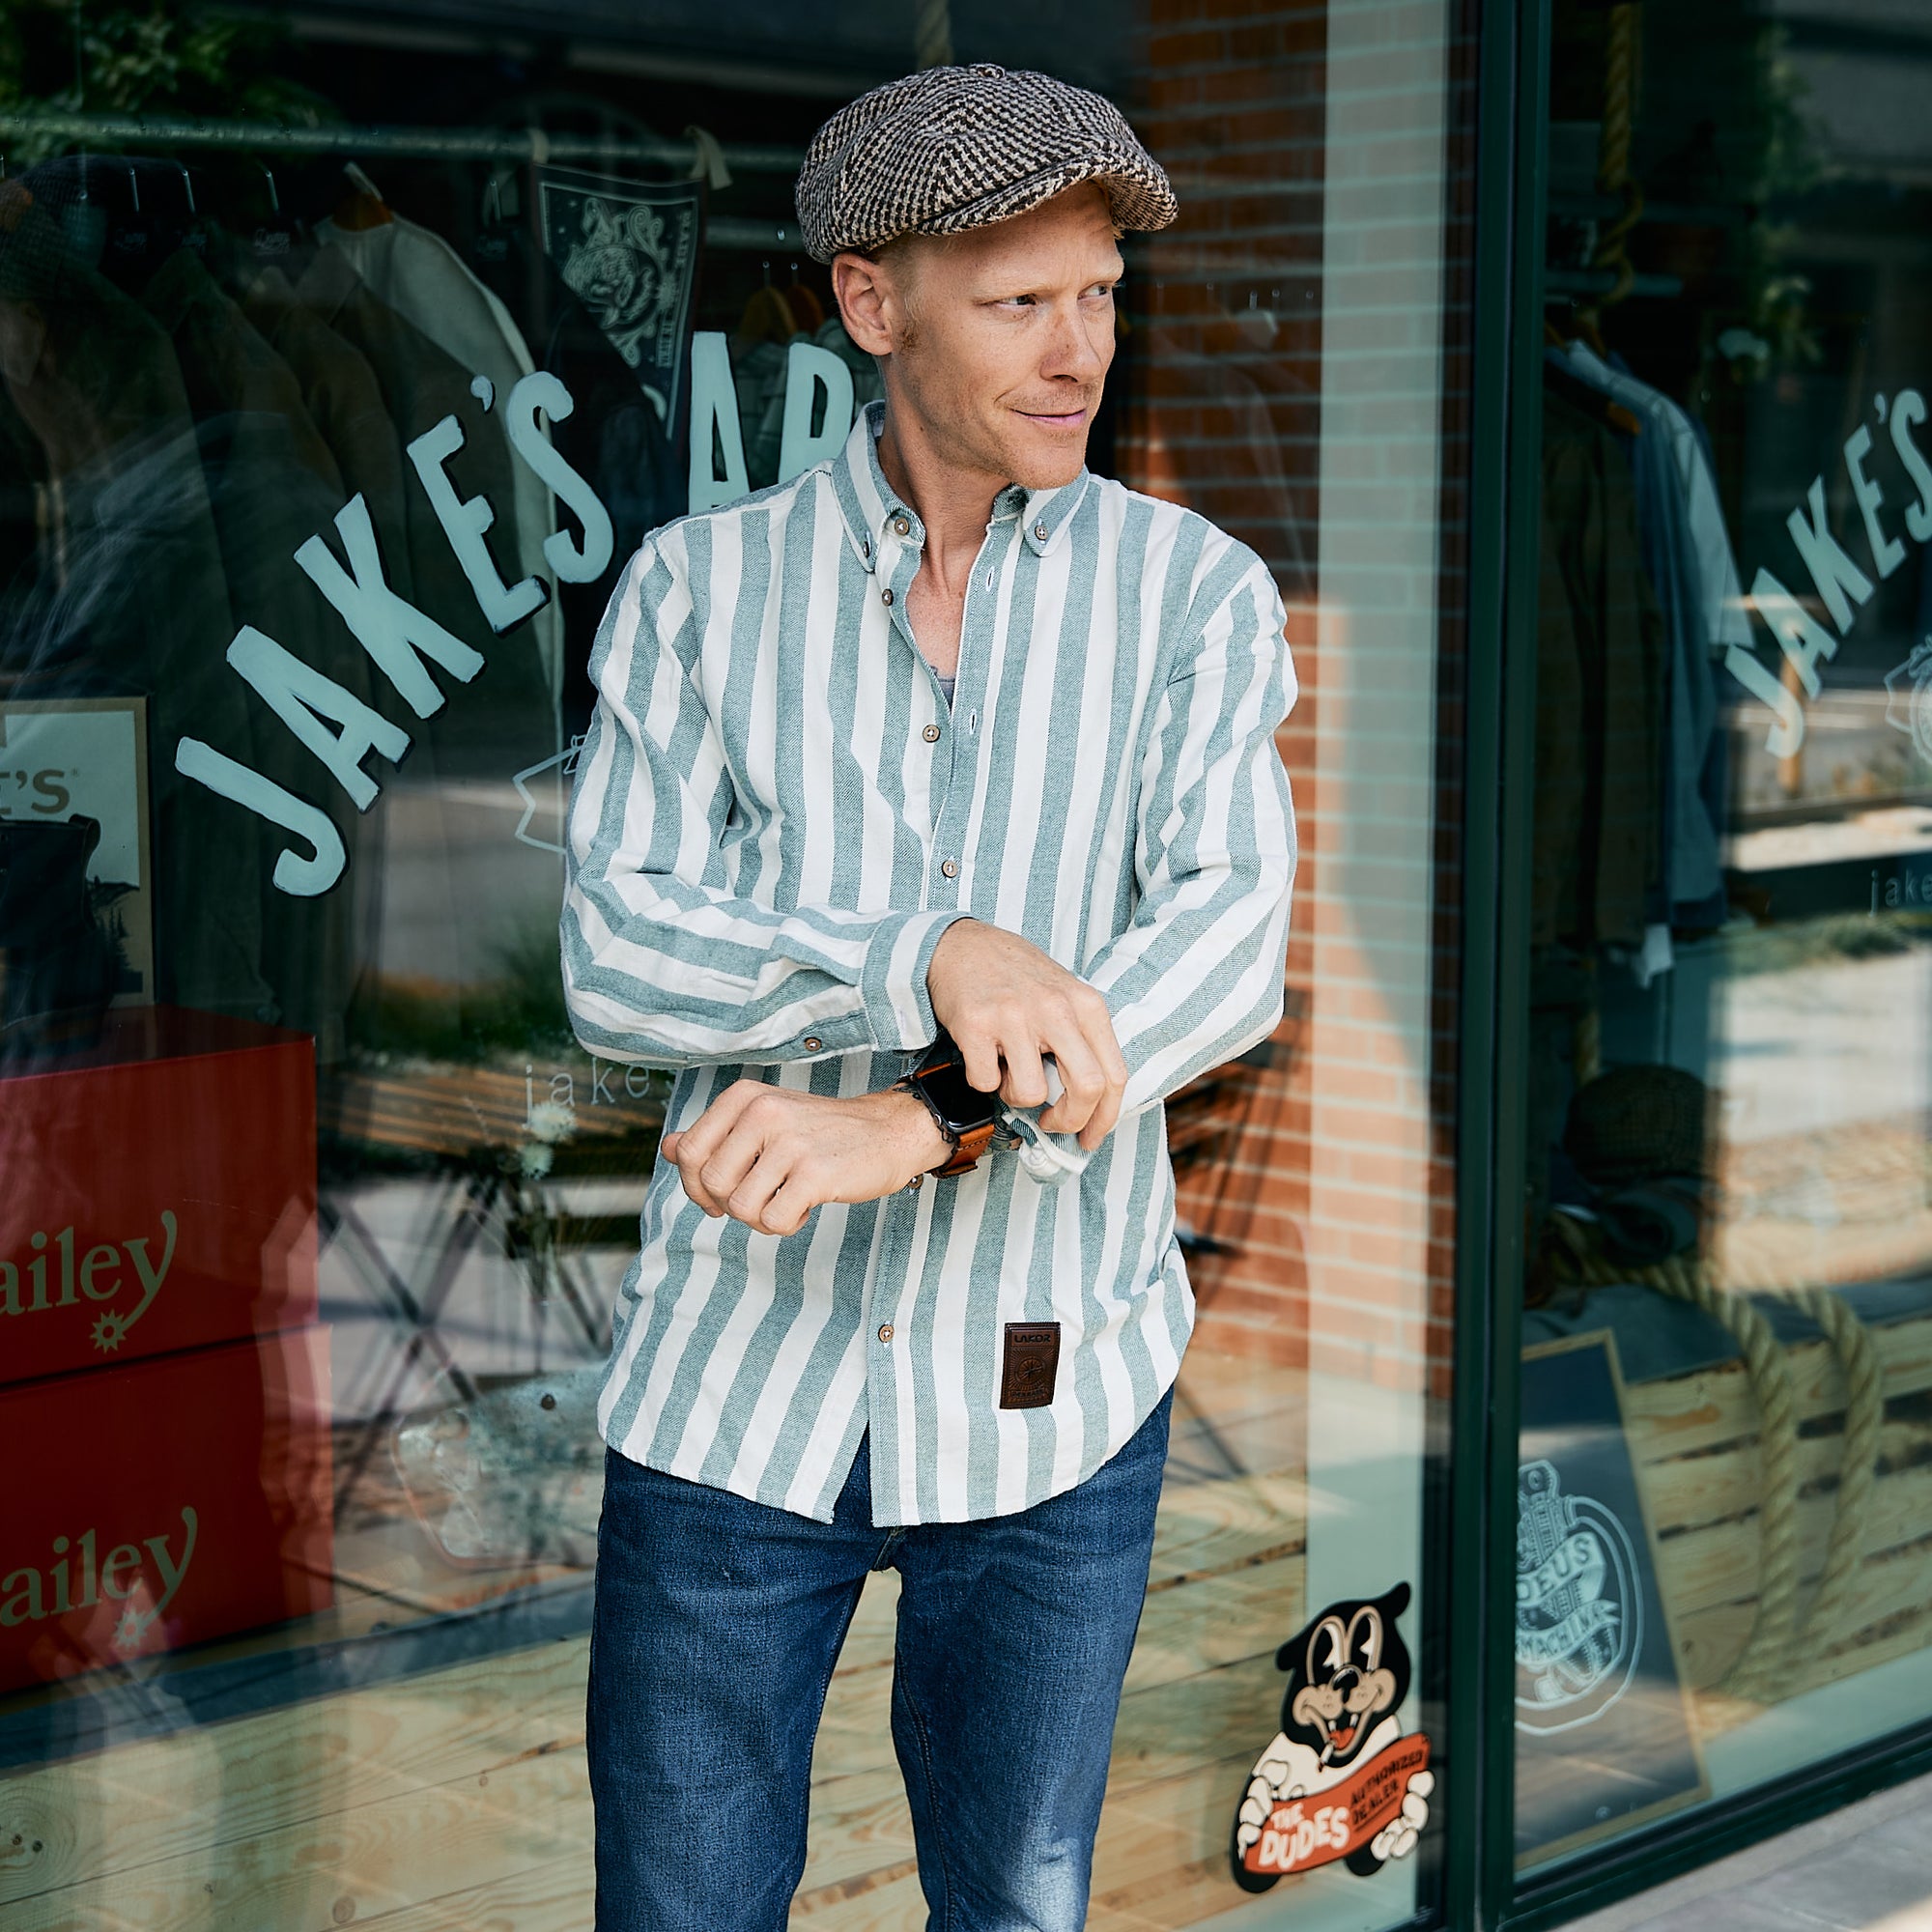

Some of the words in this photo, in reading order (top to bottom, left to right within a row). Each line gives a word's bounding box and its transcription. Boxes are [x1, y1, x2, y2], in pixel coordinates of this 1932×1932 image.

[175, 371, 614, 897] JAKE'S
[1351, 1749, 1424, 1804] AUTHORIZED
[1353, 1778, 1399, 1825] DEALER
[1258, 1805, 1350, 1871] DUDES
[1269, 1803, 1304, 1831] THE
